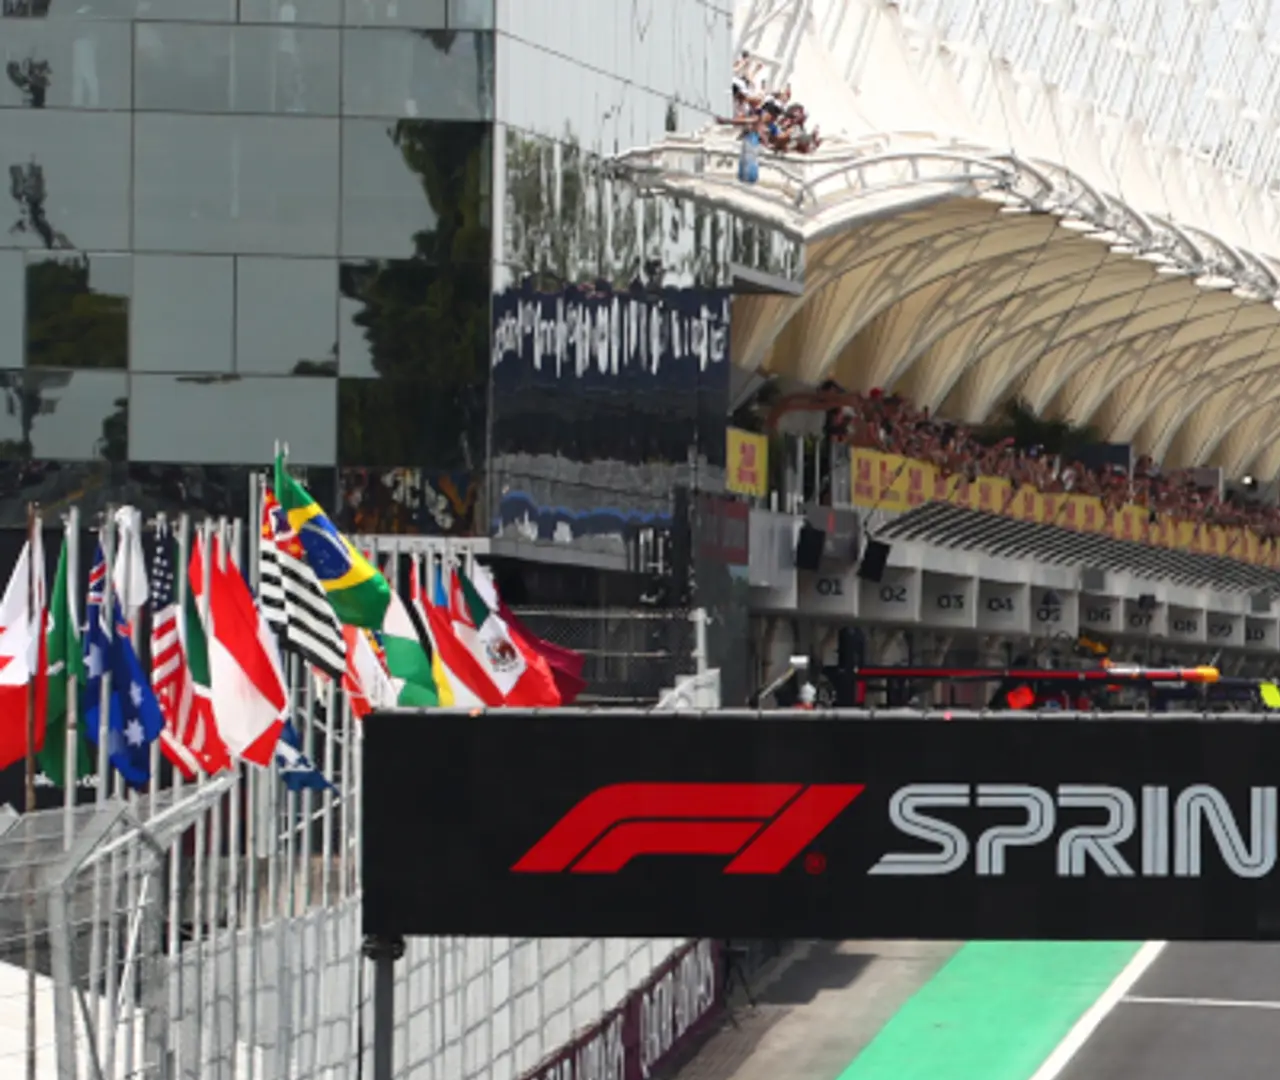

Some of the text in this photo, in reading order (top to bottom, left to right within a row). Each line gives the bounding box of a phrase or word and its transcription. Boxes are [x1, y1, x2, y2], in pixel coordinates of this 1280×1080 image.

[816, 578, 844, 596] 01
[880, 586, 908, 602] 02
[511, 782, 865, 874] F1
